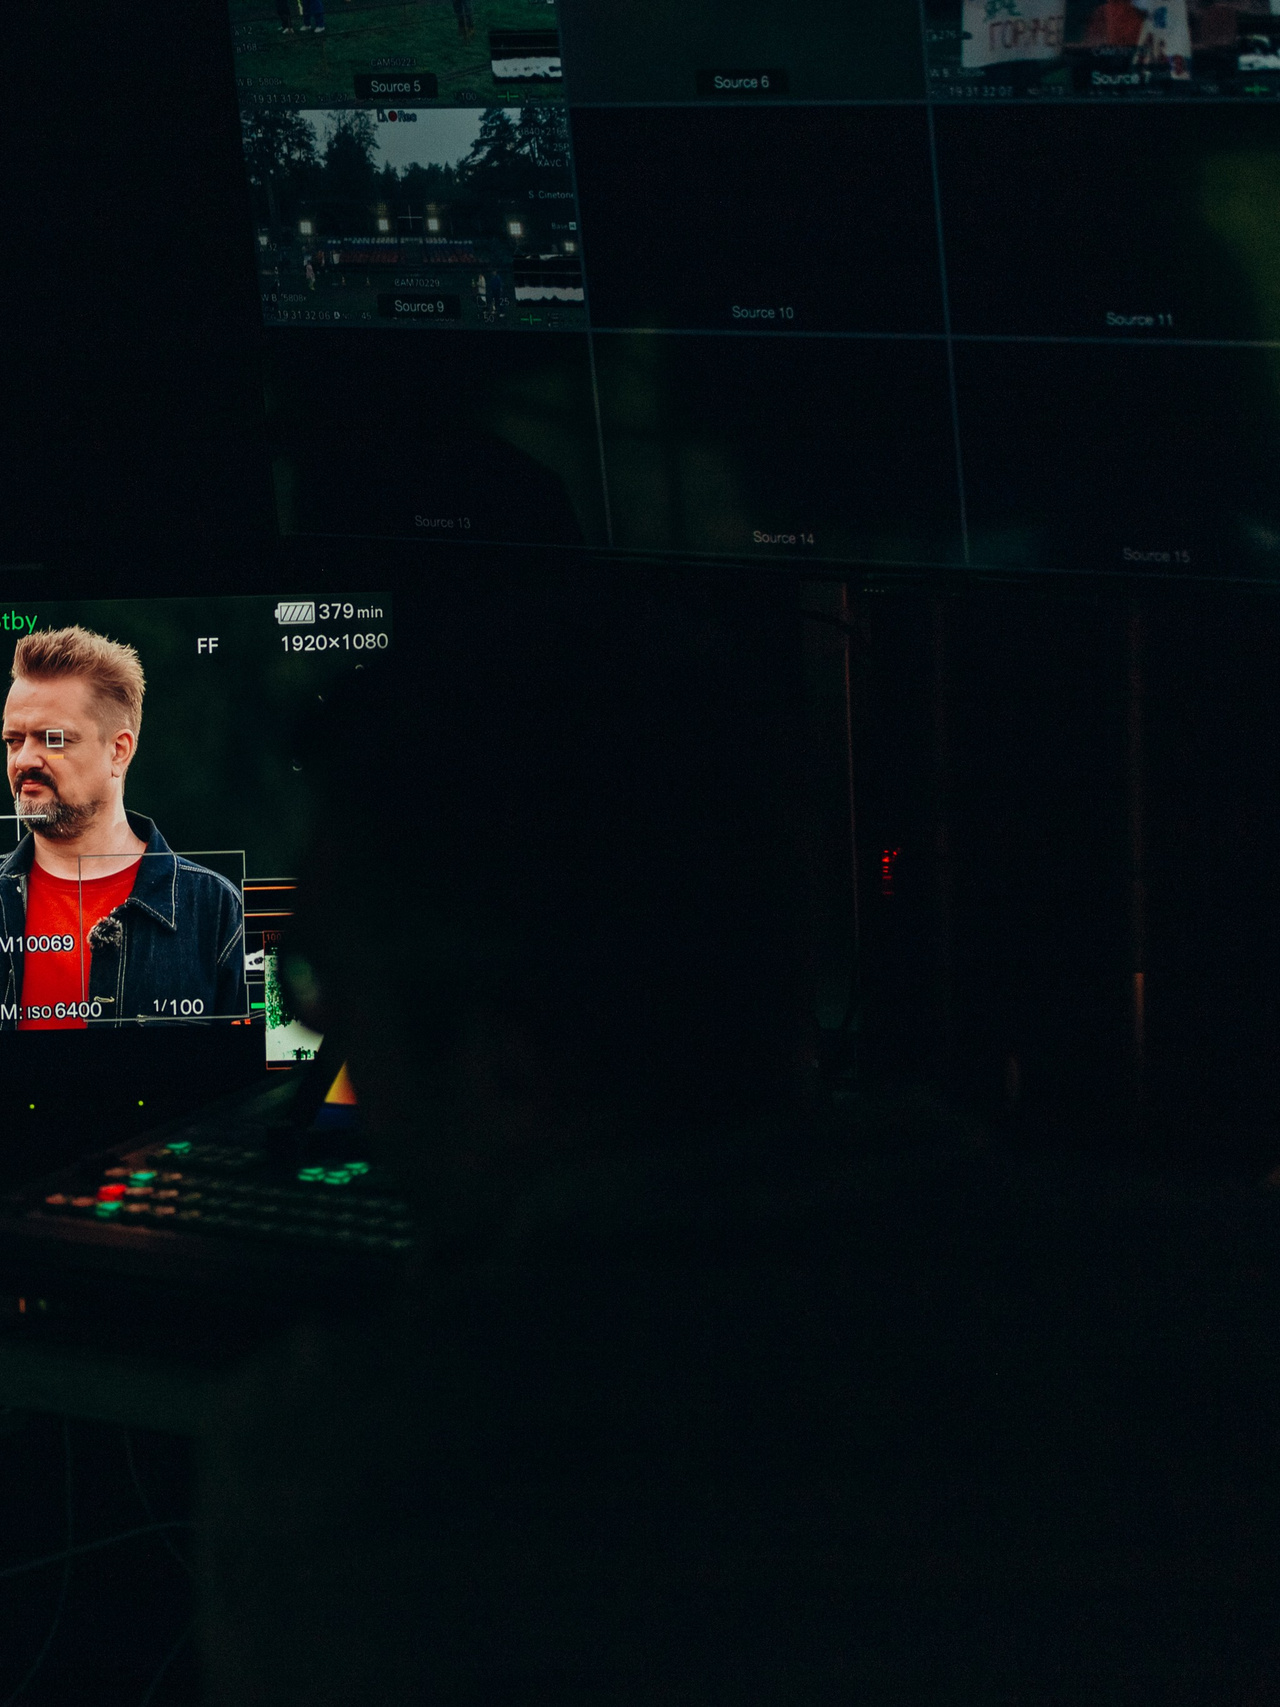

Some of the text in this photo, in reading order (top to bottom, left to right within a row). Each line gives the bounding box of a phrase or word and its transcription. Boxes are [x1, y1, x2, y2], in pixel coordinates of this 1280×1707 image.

[714, 75, 770, 89] Source 6
[1091, 69, 1140, 85] Source
[370, 80, 421, 93] Source 5
[394, 300, 445, 313] Source 9
[731, 305, 794, 319] Source 10
[1105, 311, 1153, 326] Source
[414, 514, 471, 529] Source 13
[753, 530, 814, 546] Source 14
[319, 602, 384, 620] 379 min
[197, 638, 219, 654] FF
[153, 998, 205, 1016] 1/100
